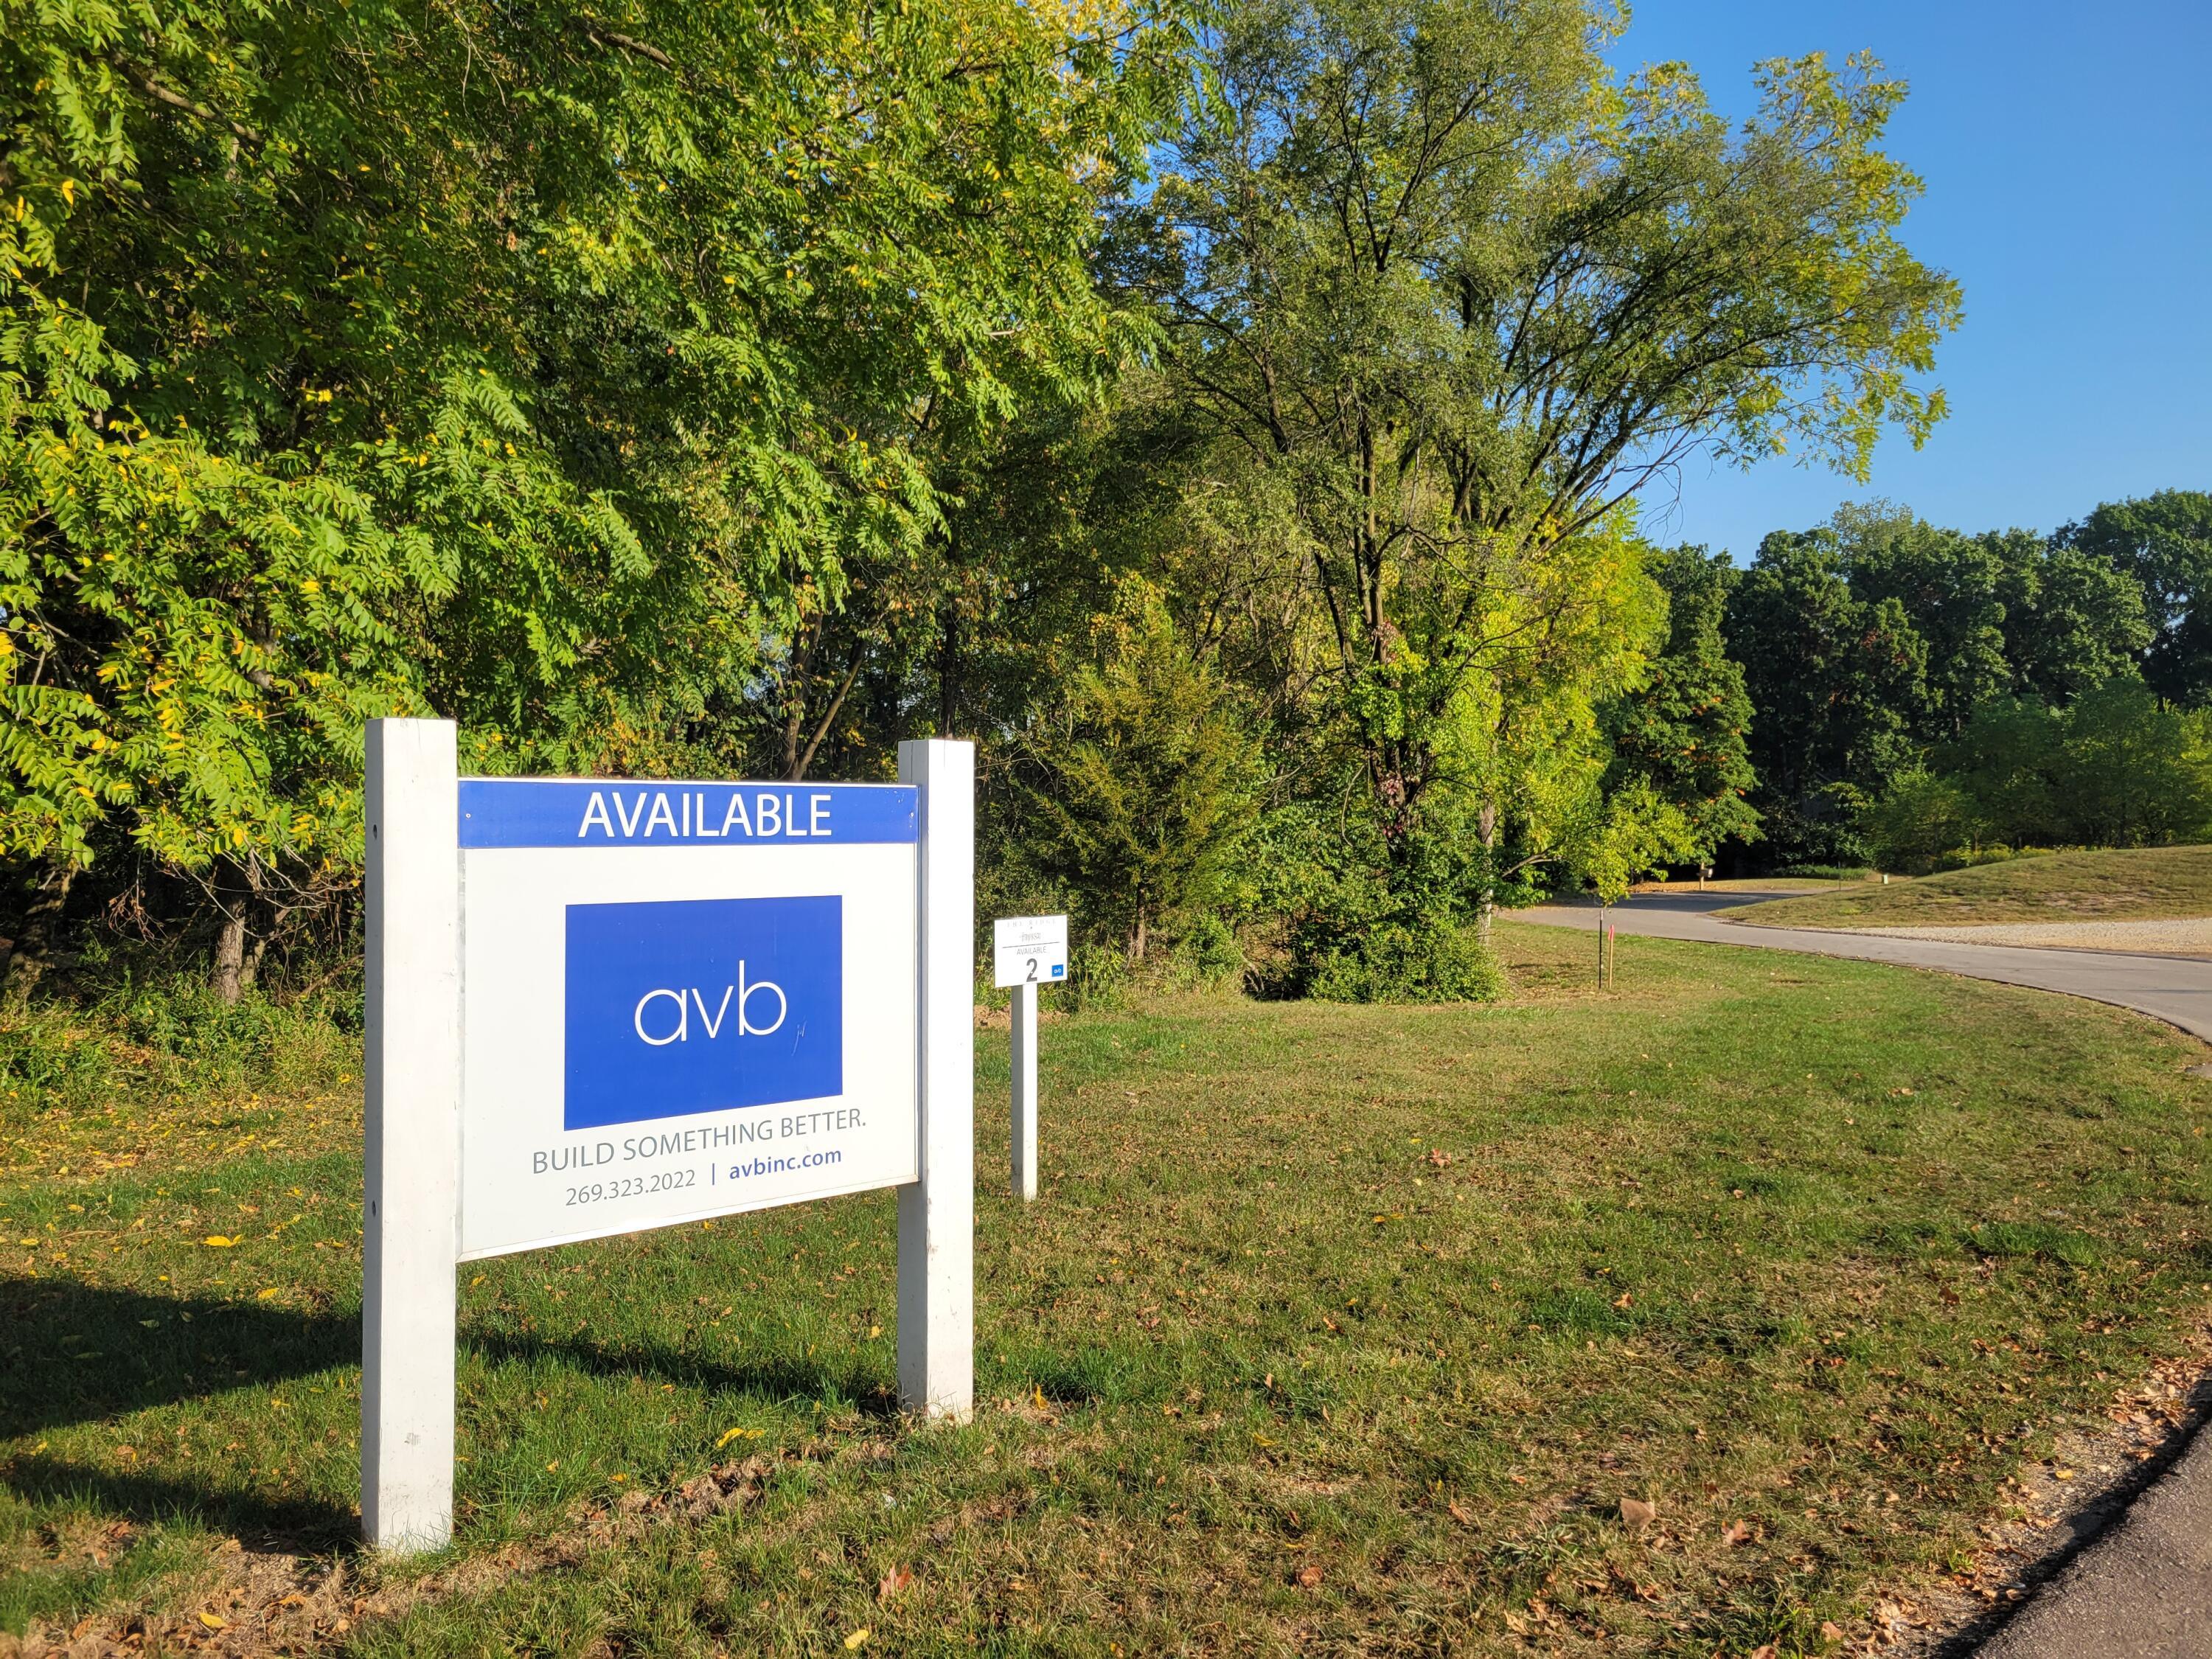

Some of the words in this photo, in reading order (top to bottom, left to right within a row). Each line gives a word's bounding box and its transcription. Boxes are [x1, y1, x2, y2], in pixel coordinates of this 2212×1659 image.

[578, 792, 832, 838] AVAILABLE
[1026, 958, 1037, 982] 2
[634, 959, 787, 1046] avb
[533, 1142, 615, 1175] BUILD
[623, 1119, 773, 1161] SOMETHING
[781, 1108, 867, 1138] BETTER.
[566, 1169, 695, 1206] 269.323.2022
[728, 1150, 842, 1180] avbinc.com
